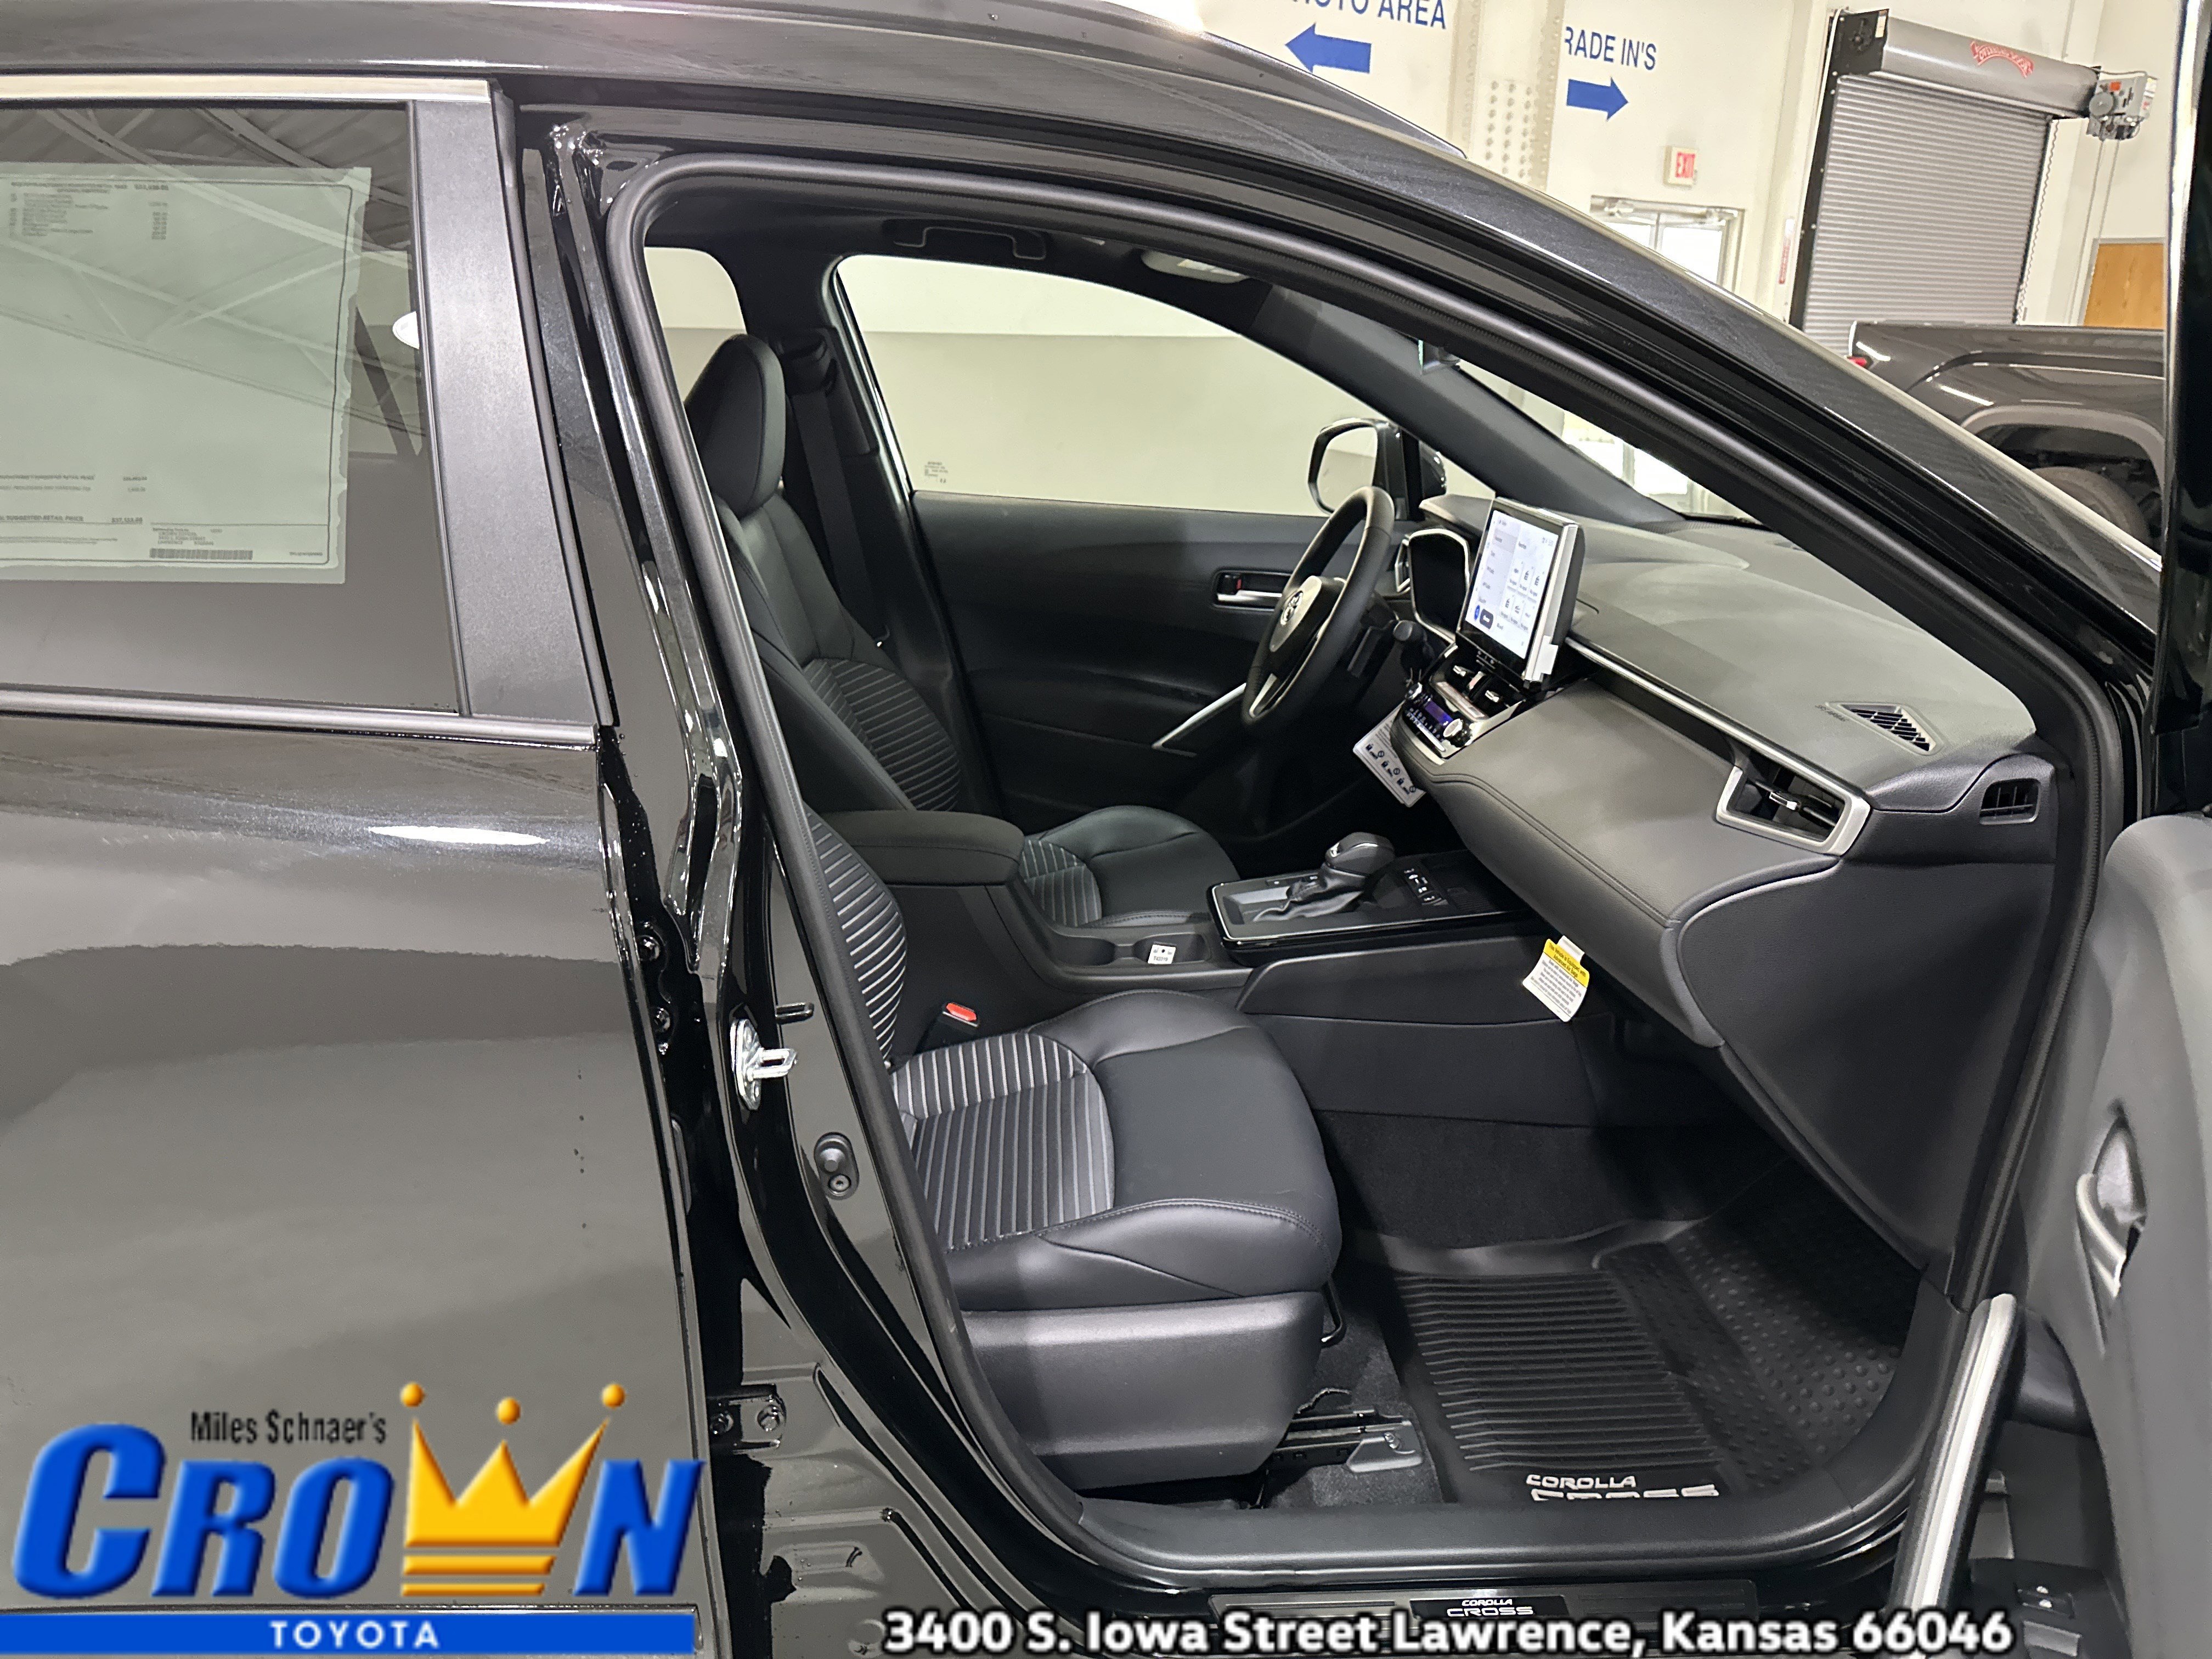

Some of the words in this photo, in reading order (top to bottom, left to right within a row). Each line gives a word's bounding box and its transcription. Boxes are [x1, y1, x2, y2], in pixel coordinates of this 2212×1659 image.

[1376, 0, 1446, 29] AREA
[1564, 26, 1616, 63] RADE
[1621, 38, 1656, 70] IN'S
[1526, 1474, 1636, 1490] COROLLA
[1447, 1606, 1533, 1617] CROSS
